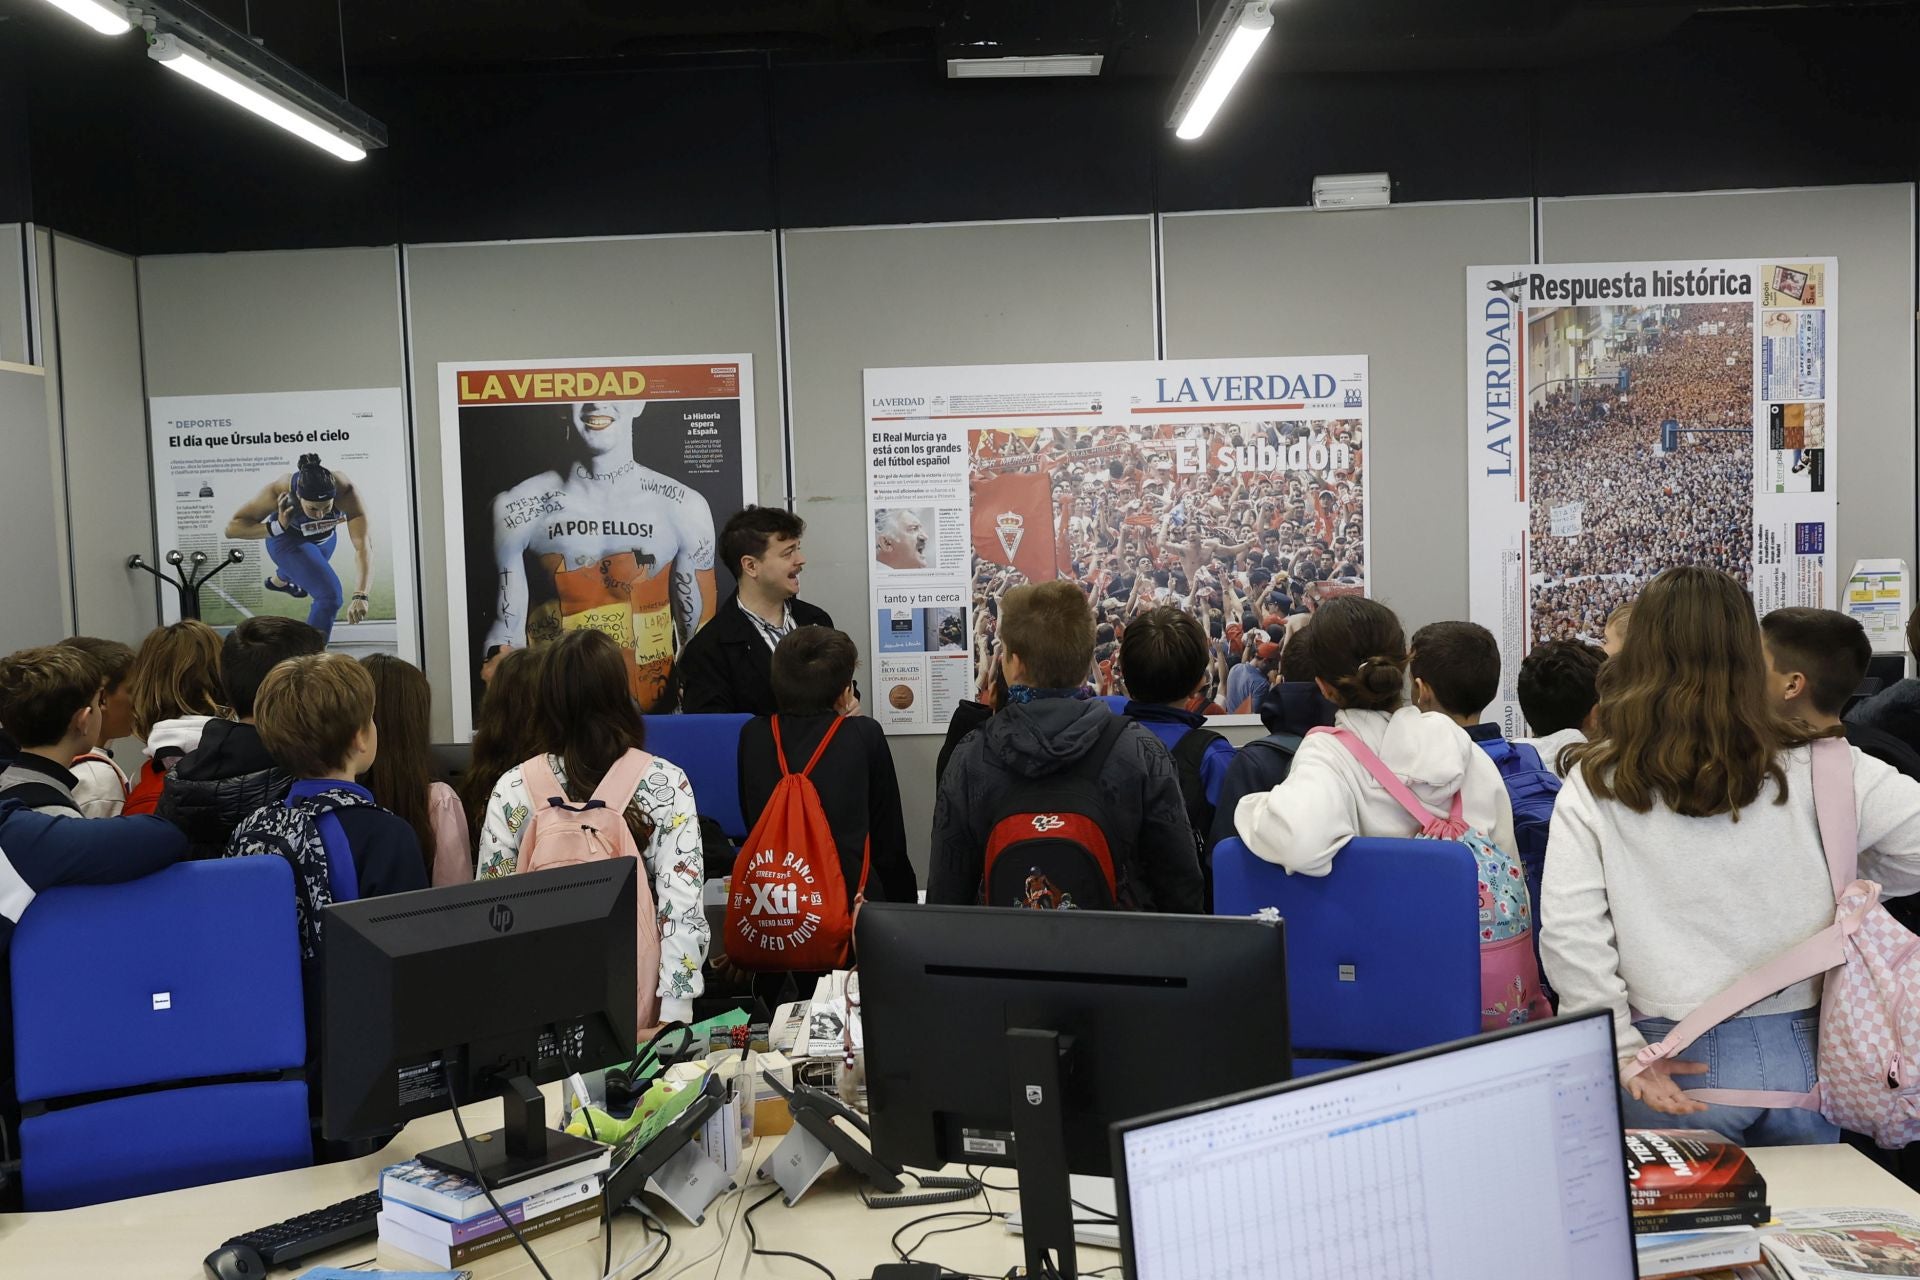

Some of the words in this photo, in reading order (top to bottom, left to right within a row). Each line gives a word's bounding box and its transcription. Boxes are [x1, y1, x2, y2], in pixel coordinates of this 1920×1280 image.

[1530, 272, 1646, 306] Respuesta
[1653, 267, 1751, 296] histórica
[1486, 298, 1512, 433] VERDAD
[461, 375, 506, 400] LA
[509, 371, 645, 398] VERDAD
[1156, 378, 1198, 403] LA
[1200, 373, 1336, 401] VERDAD
[885, 398, 924, 406] VERDAD
[176, 419, 232, 428] DEPORTES
[693, 428, 717, 436] España
[169, 436, 180, 447] El
[183, 435, 202, 447] día
[205, 436, 228, 448] que
[231, 431, 271, 445] Úrsula
[274, 431, 303, 443] besó
[307, 430, 317, 441] el
[320, 429, 349, 441] cielo
[873, 433, 880, 442] El
[884, 433, 902, 441] Real
[905, 432, 934, 441] Murcia
[936, 433, 946, 442] ya
[873, 445, 892, 454] está
[912, 445, 924, 453] los
[927, 444, 961, 455] grandes
[873, 457, 886, 466] del
[889, 456, 914, 466] fútbol
[916, 456, 950, 467] español
[1176, 439, 1206, 474] El
[1218, 433, 1350, 472] subidón
[1487, 435, 1512, 477] LA
[549, 523, 564, 540] ¡A
[567, 520, 598, 535] POR
[602, 521, 653, 538] ELLOS!
[884, 594, 907, 603] tanto
[910, 596, 915, 604] y
[918, 594, 933, 602] tan
[936, 593, 960, 602] cerca
[1505, 706, 1513, 738] ERDAD
[750, 883, 797, 915] Xti
[737, 916, 757, 942] THE
[760, 934, 784, 950] RED
[787, 912, 821, 947] TOUCH
